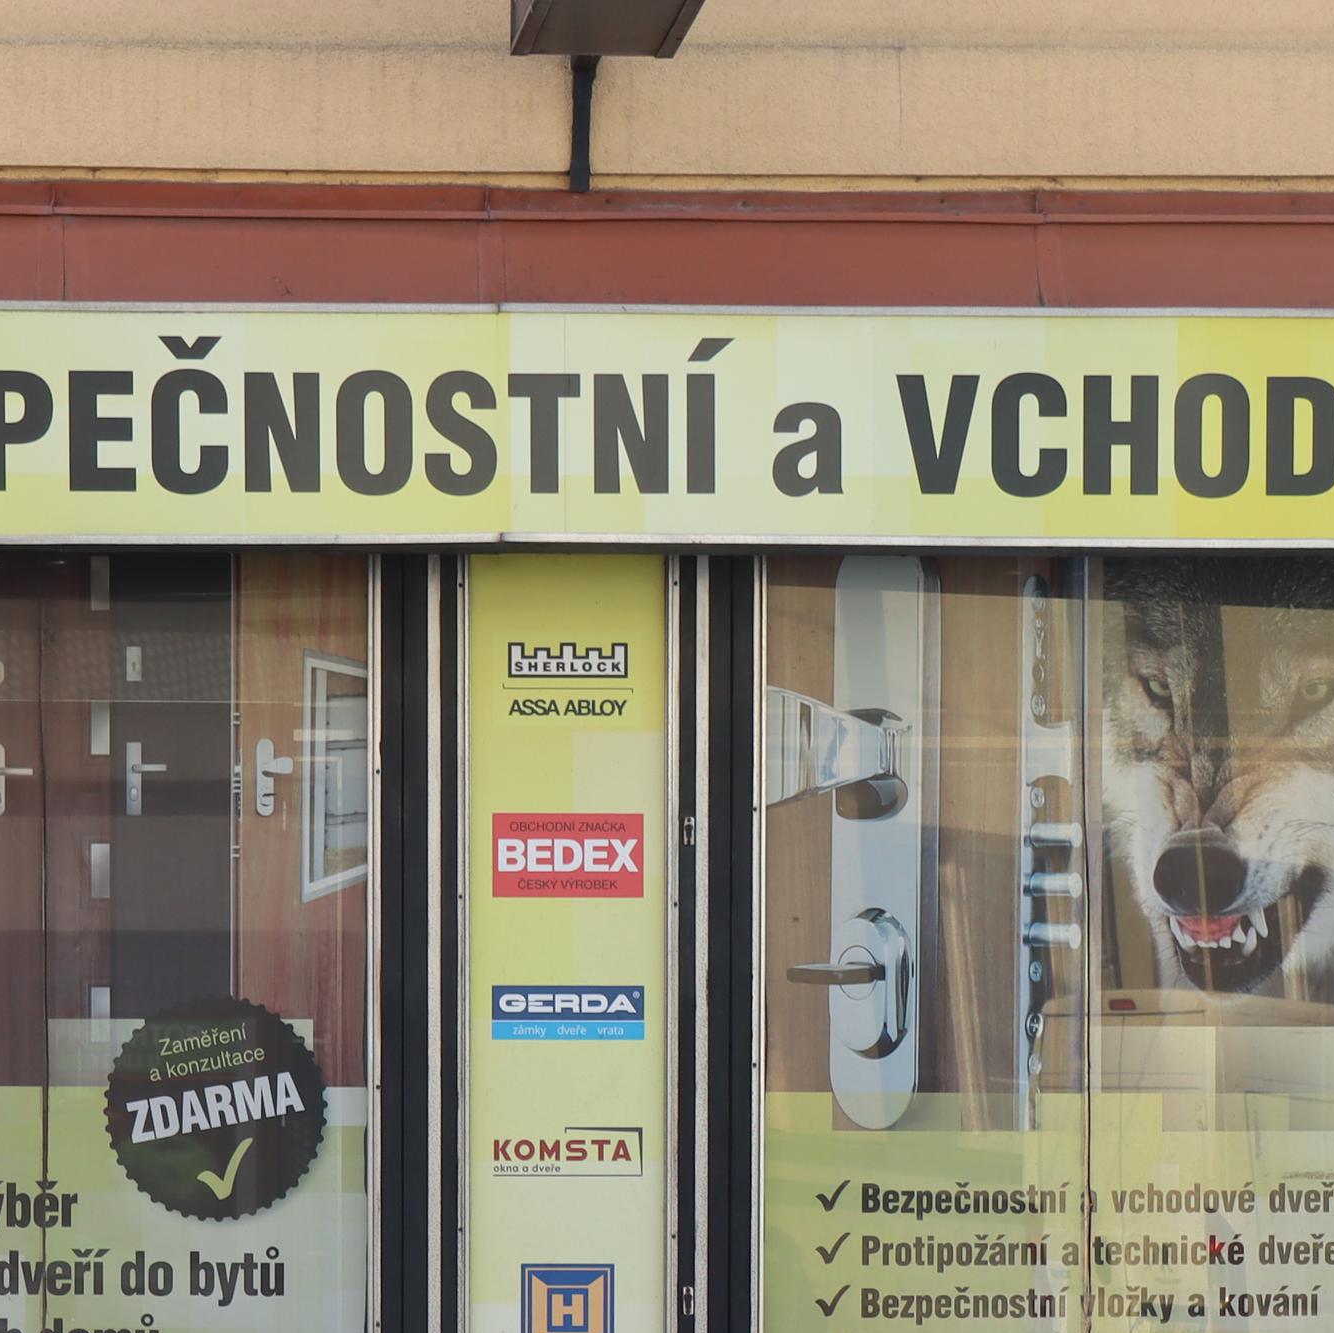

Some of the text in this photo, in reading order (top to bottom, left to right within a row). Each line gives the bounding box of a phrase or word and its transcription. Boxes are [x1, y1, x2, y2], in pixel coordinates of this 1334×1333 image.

[771, 402, 844, 497] a
[514, 661, 622, 673] SHERLOCK
[509, 699, 627, 717] ASSA ABLOY
[509, 819, 626, 833] OBCHODNÍ ZNAČKA
[497, 838, 639, 873] BEDEX
[517, 876, 618, 891] ČESKÝ VÝROBEK
[499, 993, 637, 1014] GERDA
[159, 1022, 247, 1057] Zaměření
[512, 1024, 624, 1038] zámky dveře vrata
[150, 1047, 266, 1082] a konzultace
[126, 1071, 306, 1144] ZDARMA
[493, 1139, 632, 1161] KOMSTA
[532, 1164, 561, 1174] dveře
[861, 1181, 1070, 1217] Bezpečnostní
[1080, 1189, 1098, 1214] a
[1112, 1182, 1255, 1214] vchodové
[861, 1233, 1051, 1273] Protipožární
[1061, 1240, 1079, 1266] a
[1092, 1233, 1245, 1266] technické
[121, 1250, 174, 1297] do
[189, 1246, 286, 1307] bytů
[860, 1285, 1322, 1325] Bezpečnostní vložky a kování
